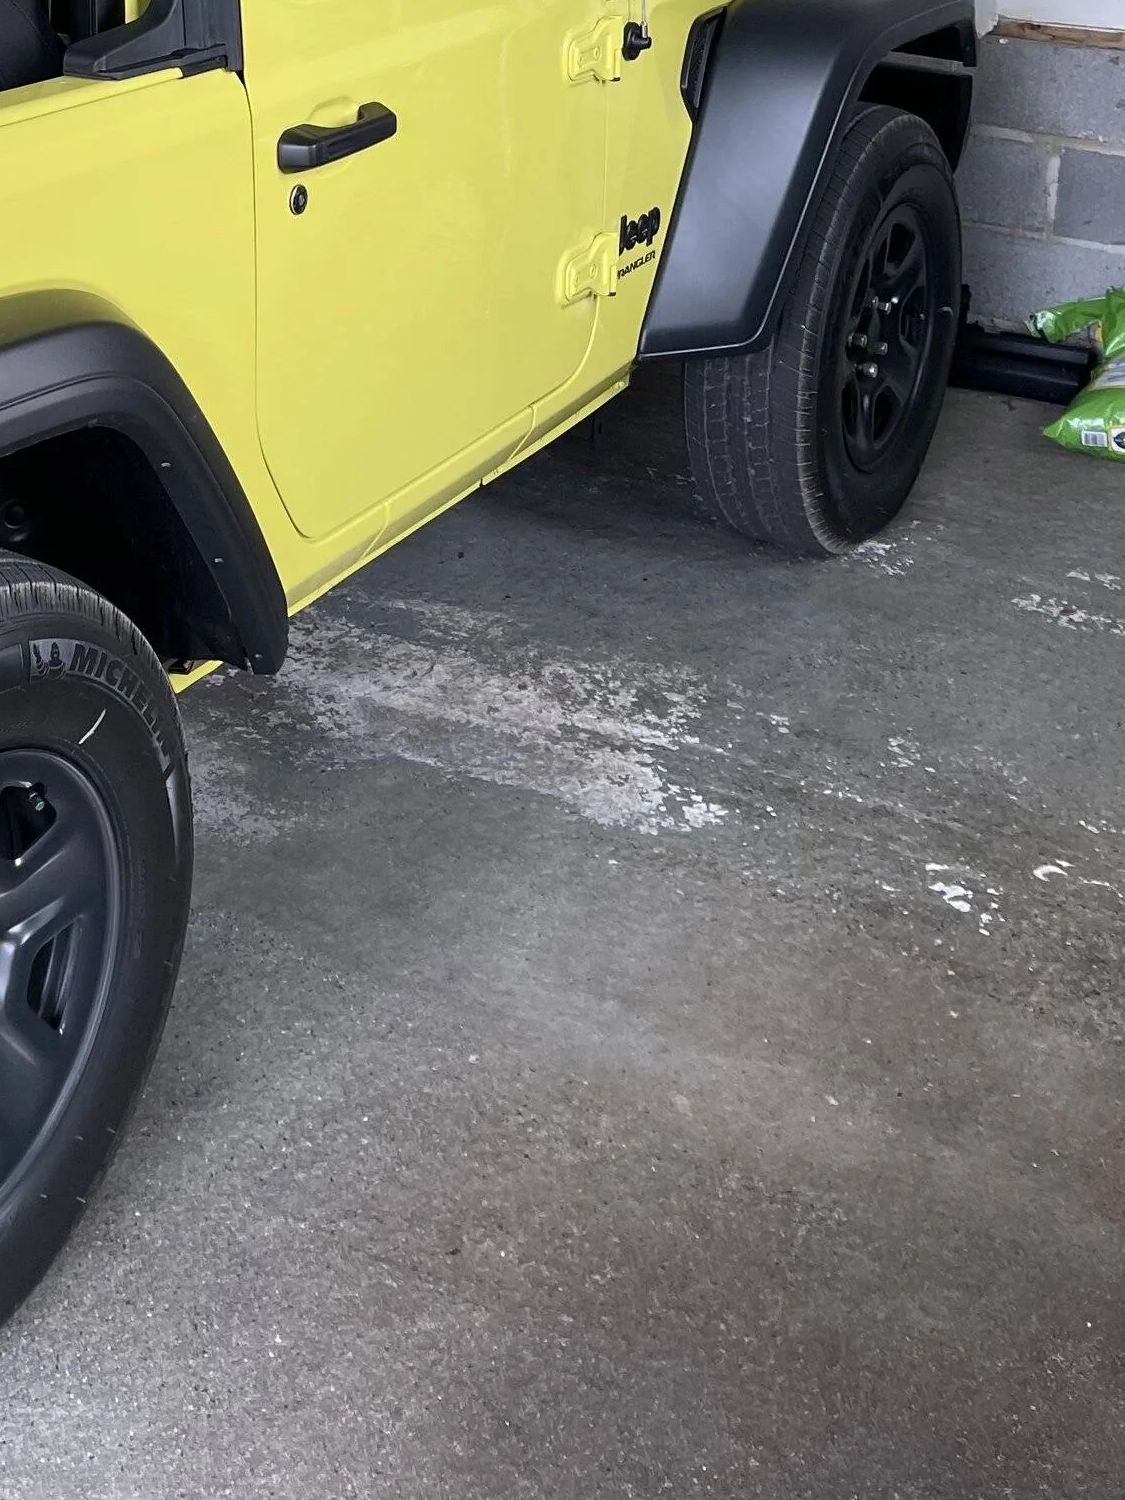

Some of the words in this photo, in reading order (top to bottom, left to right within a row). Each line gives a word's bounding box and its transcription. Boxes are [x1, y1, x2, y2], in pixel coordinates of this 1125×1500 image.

[618, 206, 661, 256] Jeep
[616, 250, 656, 280] RANGLER
[68, 642, 172, 762] MICHELIN
